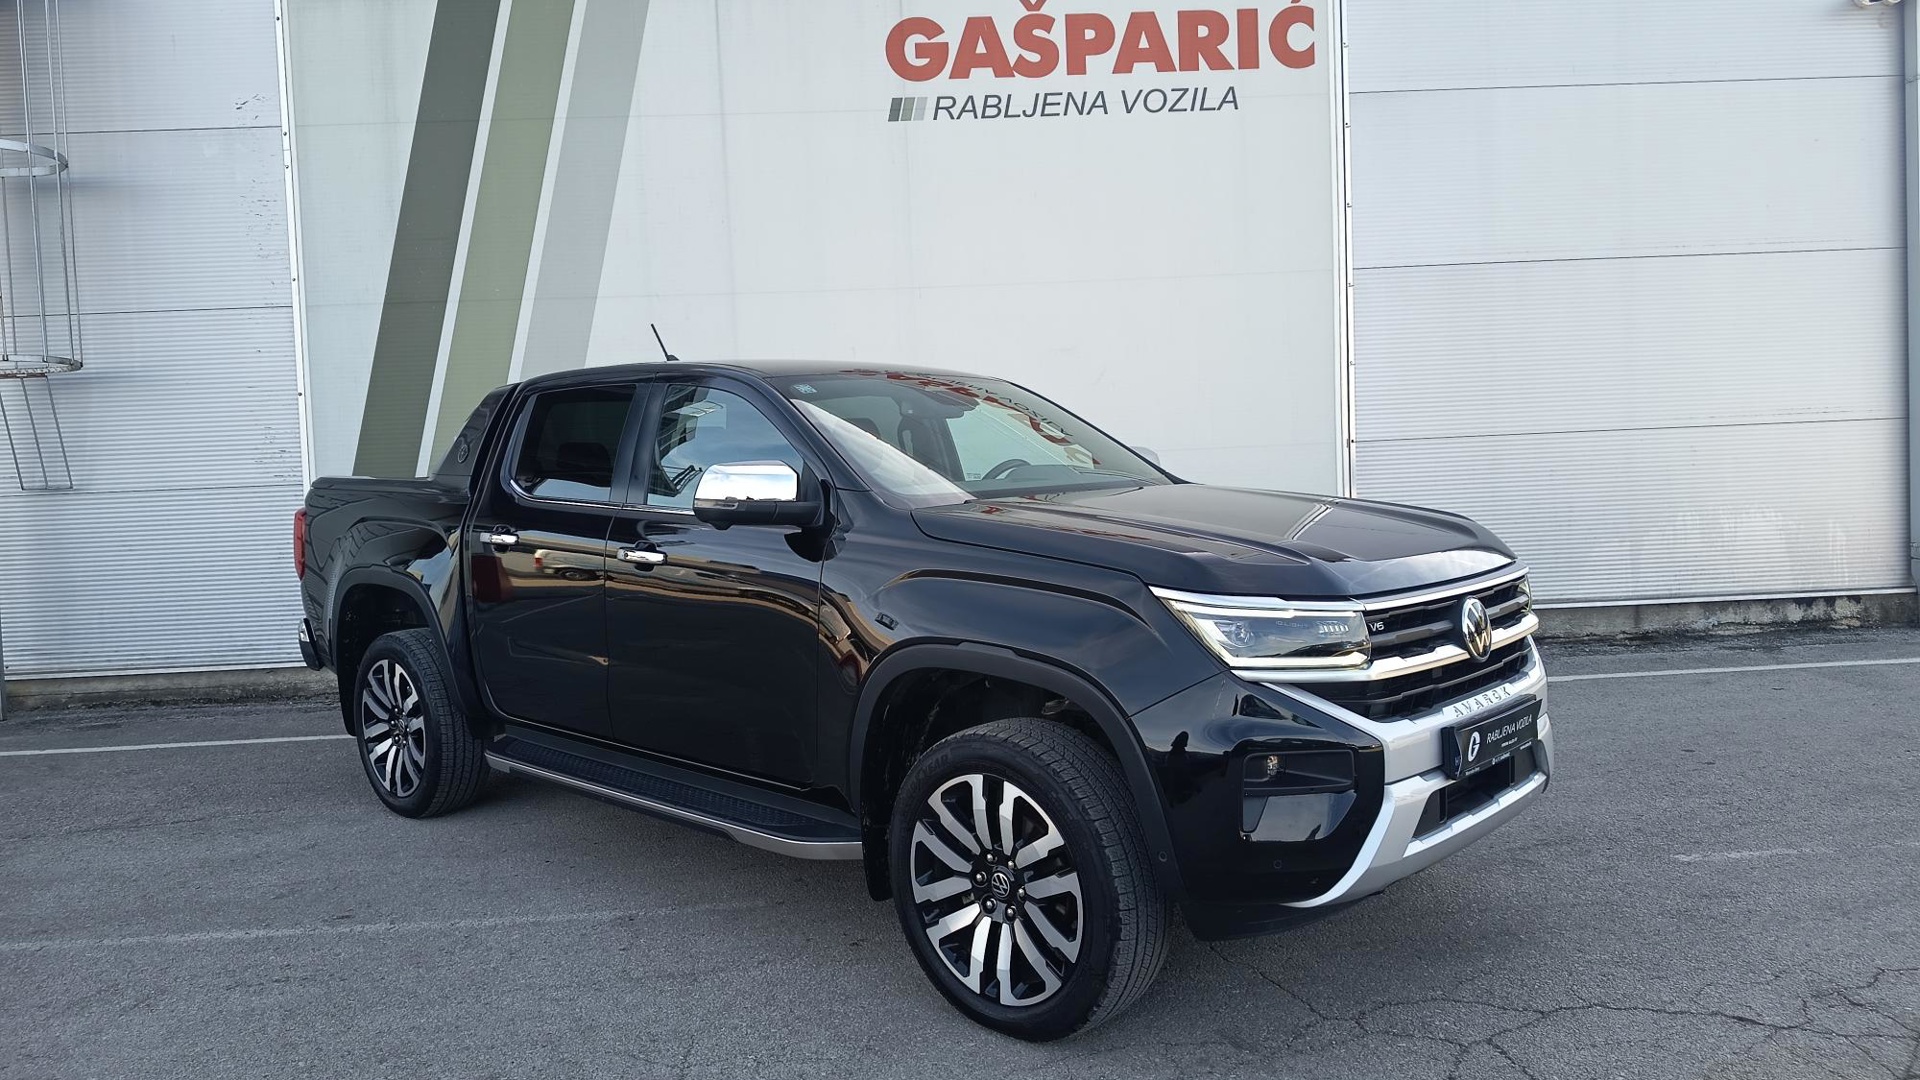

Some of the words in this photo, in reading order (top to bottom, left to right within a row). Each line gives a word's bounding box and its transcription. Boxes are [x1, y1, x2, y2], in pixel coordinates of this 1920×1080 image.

[885, 0, 1316, 82] GAŠPARIĆ
[932, 91, 1109, 121] RABLJENA
[1121, 86, 1239, 115] VOZILA
[1370, 621, 1385, 632] V6
[1486, 722, 1516, 744] RABLJENA
